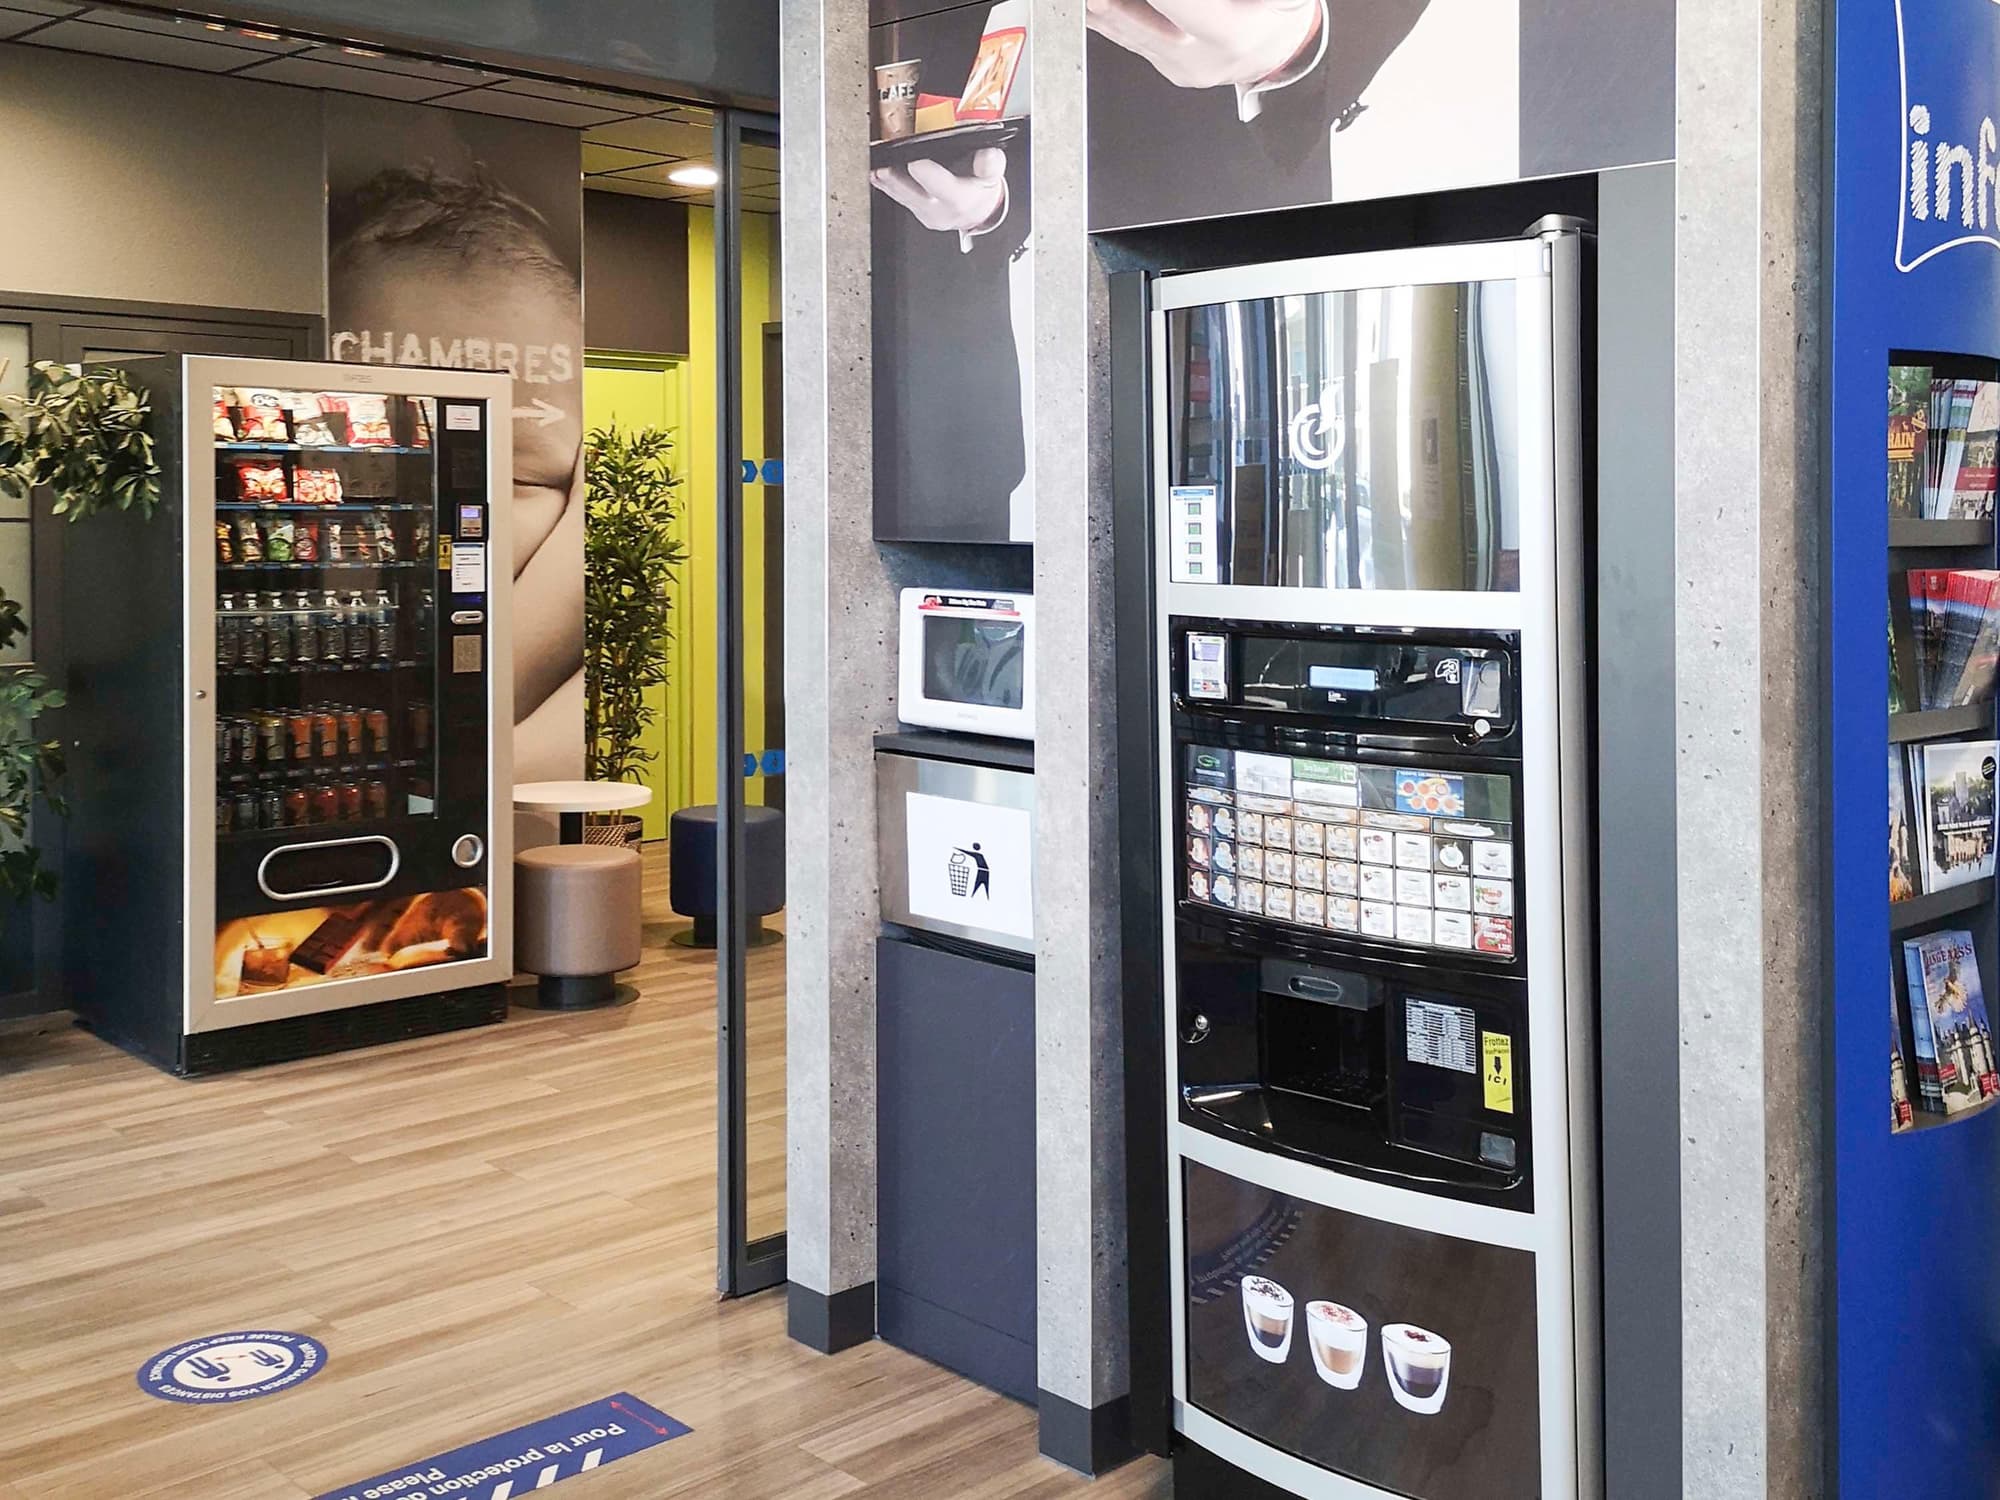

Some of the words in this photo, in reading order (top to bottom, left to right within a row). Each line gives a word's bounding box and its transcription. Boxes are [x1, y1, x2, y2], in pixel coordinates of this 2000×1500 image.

[1909, 104, 2000, 232] inf
[332, 330, 573, 384] CHAMBRES
[158, 1384, 226, 1399] DISTANCES
[228, 1387, 258, 1398] VOS
[543, 1442, 573, 1455] la
[570, 1422, 627, 1447] Pour
[363, 1467, 447, 1500] Please
[427, 1448, 546, 1496] protection
